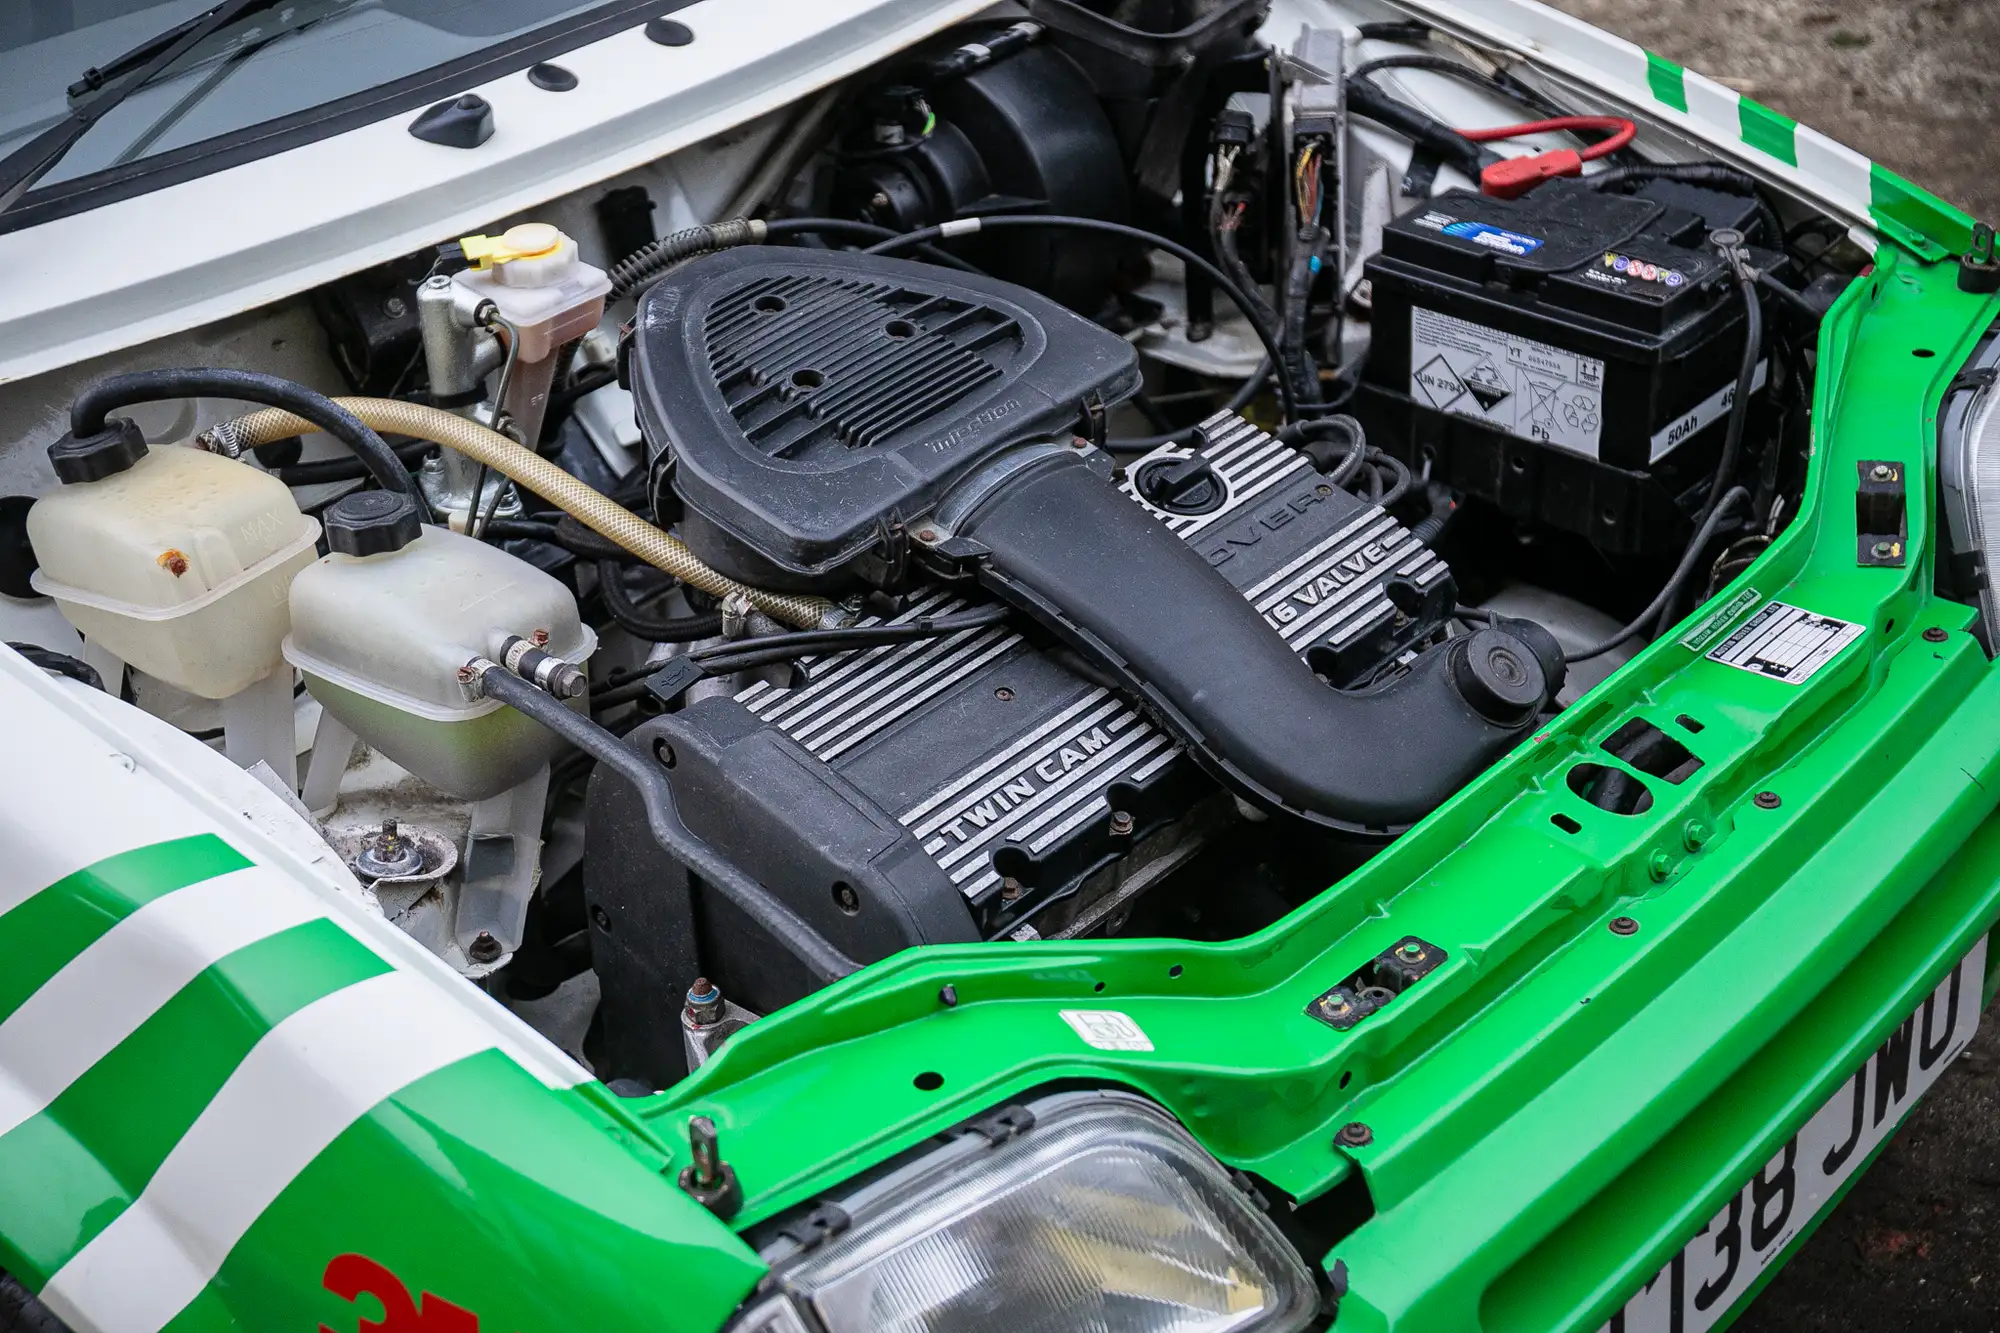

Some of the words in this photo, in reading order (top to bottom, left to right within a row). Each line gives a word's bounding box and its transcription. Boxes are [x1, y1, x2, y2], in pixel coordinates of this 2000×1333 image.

[1508, 345, 1522, 358] YT
[1419, 371, 1435, 386] UN
[1437, 378, 1463, 394] 2794
[1531, 424, 1550, 440] Pb
[1667, 415, 1698, 445] 50Ah
[240, 507, 284, 543] MAX
[1207, 492, 1325, 567] OVER
[1262, 601, 1299, 631] 16
[1292, 542, 1387, 606] VALVE
[940, 776, 1037, 843] TWIN
[1034, 725, 1112, 784] CAM
[1608, 1132, 1799, 1333] 138
